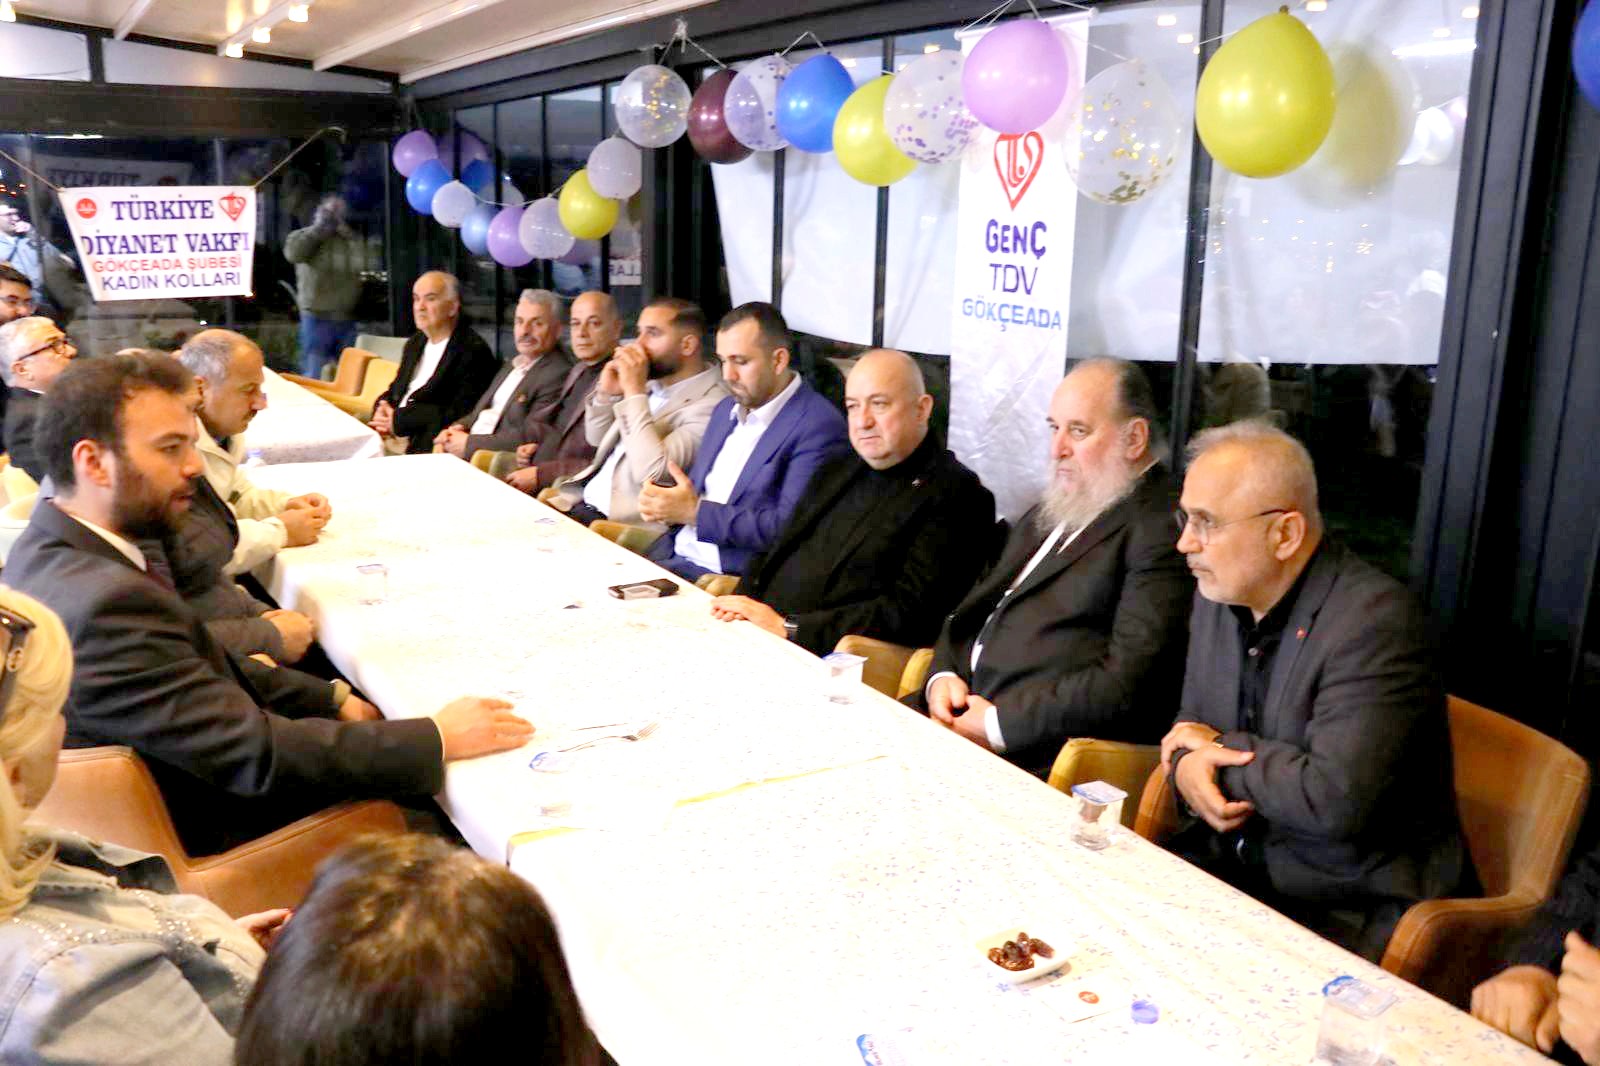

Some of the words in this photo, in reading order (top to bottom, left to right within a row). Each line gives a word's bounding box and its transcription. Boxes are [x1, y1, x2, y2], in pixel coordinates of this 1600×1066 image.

[111, 194, 214, 220] TÜRKİYE
[80, 229, 177, 256] DİYANET
[185, 232, 250, 253] VAKFI
[985, 218, 1047, 260] GENÇ
[92, 256, 184, 274] GÖKÇEADA
[187, 253, 242, 273] ŞUBESİ
[101, 275, 158, 291] KADIN
[165, 271, 241, 288] KOLLARI
[989, 263, 1039, 295] TDV
[962, 295, 1062, 332] GÖKÇEADA
